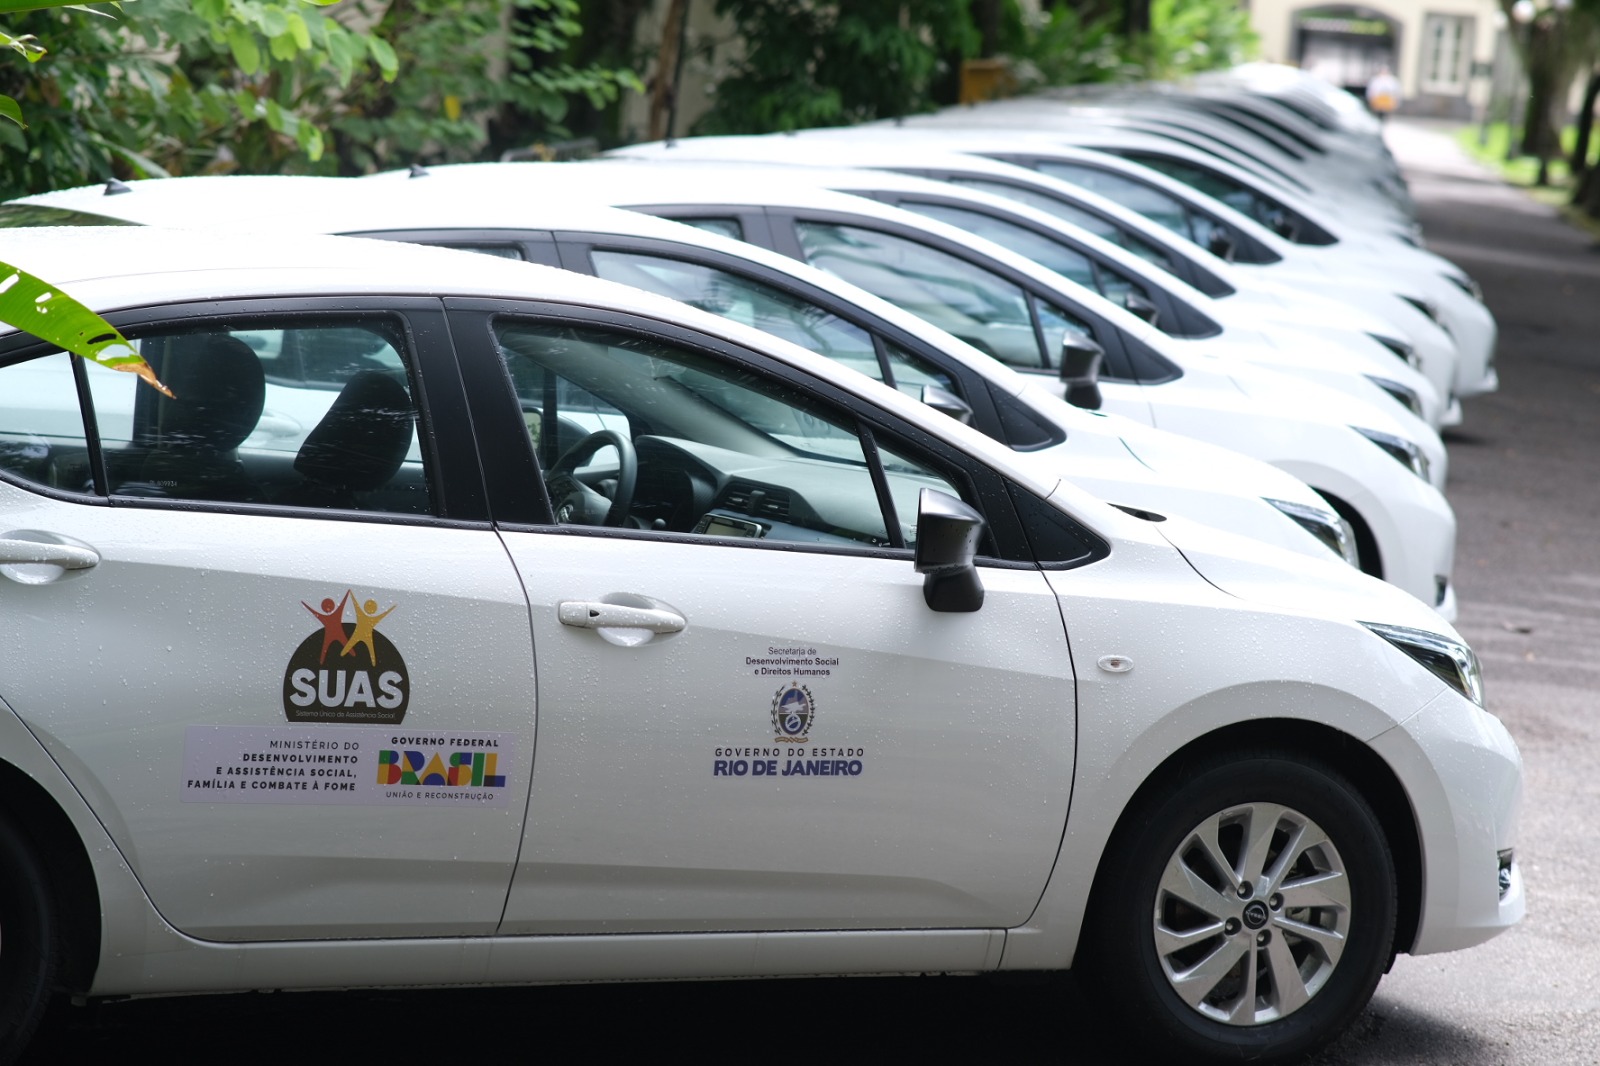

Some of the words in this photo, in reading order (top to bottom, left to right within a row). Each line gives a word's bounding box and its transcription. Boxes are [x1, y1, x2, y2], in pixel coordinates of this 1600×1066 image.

[768, 647, 805, 656] Secretaria
[807, 647, 817, 656] de
[745, 656, 814, 666] Desenvolvimento
[814, 657, 839, 666] Social
[754, 668, 760, 676] e
[761, 667, 792, 676] Direitos
[793, 668, 831, 677] Humanos
[289, 668, 403, 709] SUAS
[269, 740, 339, 750] MINISTÉRIO
[343, 742, 360, 750] DO
[391, 736, 445, 746] GOVERNO
[449, 738, 499, 747] FEDERAL
[714, 748, 781, 757] GOVERNO
[787, 748, 805, 757] DO
[812, 748, 865, 757] ESTADO
[243, 753, 358, 763] DESENVOLVIMENTO
[216, 766, 222, 775] E
[226, 765, 305, 777] ASSISTÊNCIA
[309, 768, 357, 779] SOCIAL,
[376, 750, 506, 788] BRASIL
[713, 760, 749, 777] RIO
[752, 760, 778, 777] DE
[781, 760, 863, 777] JANEIRO
[187, 779, 235, 789] FAMÍLIA
[240, 781, 247, 789] E
[251, 781, 308, 790] COMBATE
[312, 781, 319, 790] À
[324, 783, 356, 791] FOME
[385, 791, 414, 799] UNIÃO
[424, 792, 494, 801] RECONSTRUÇÃO
